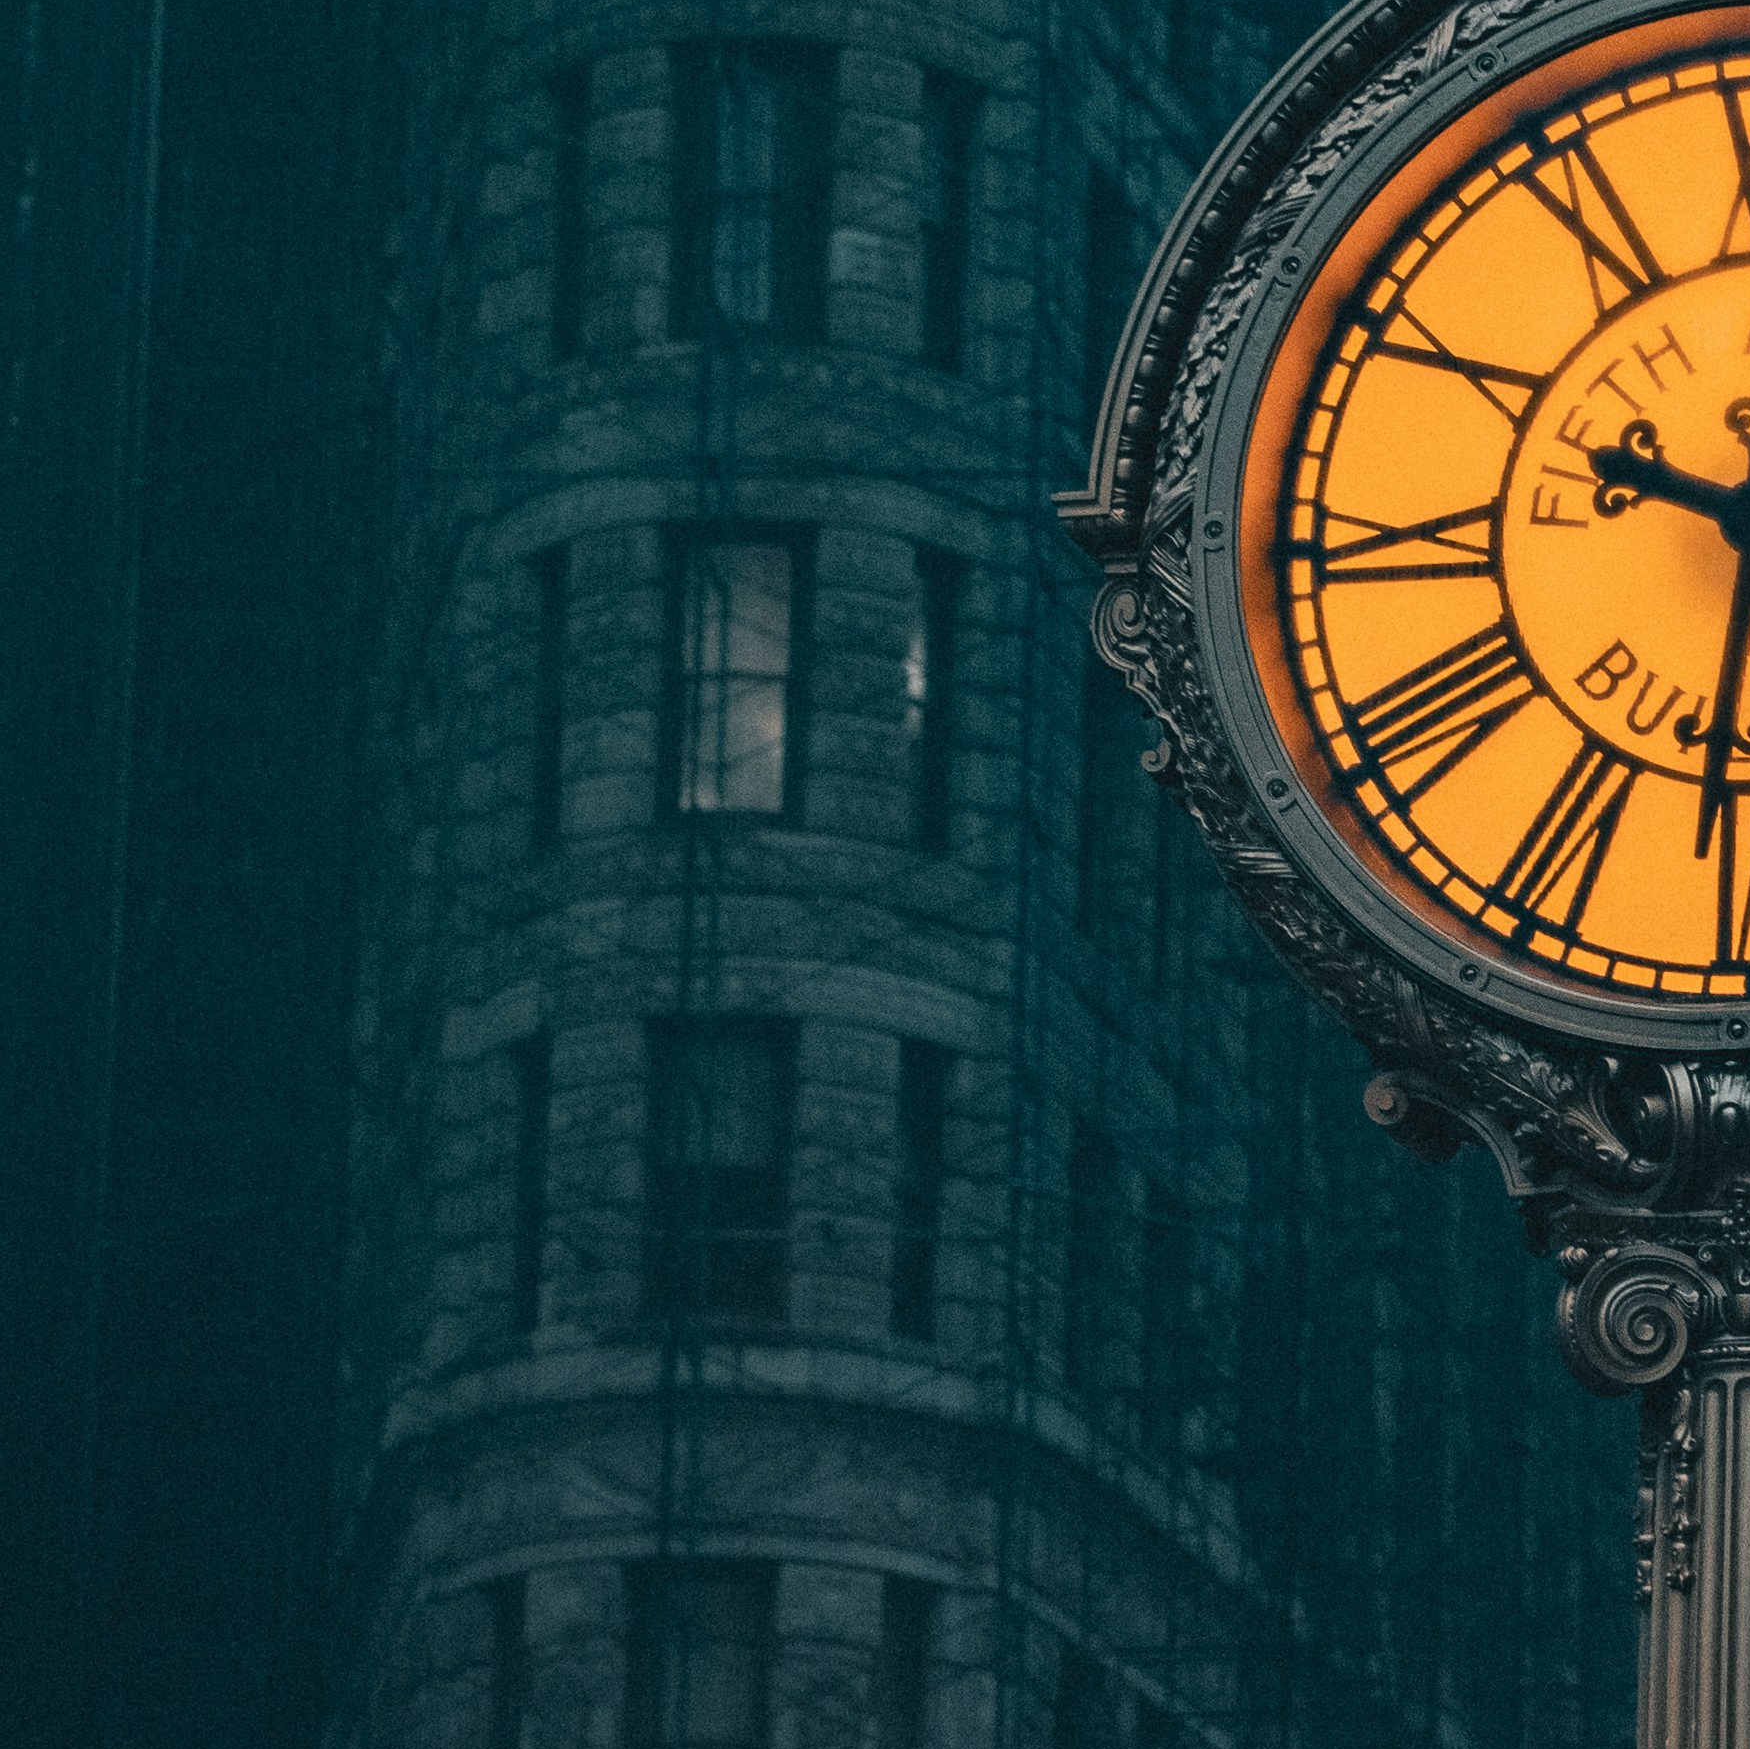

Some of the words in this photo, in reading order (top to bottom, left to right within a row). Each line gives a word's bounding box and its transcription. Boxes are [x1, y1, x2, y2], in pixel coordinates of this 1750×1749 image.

[1518, 138, 1669, 322] XI
[1364, 297, 1552, 433] X
[1530, 323, 1696, 529] FIFTH
[1316, 497, 1504, 585] IX
